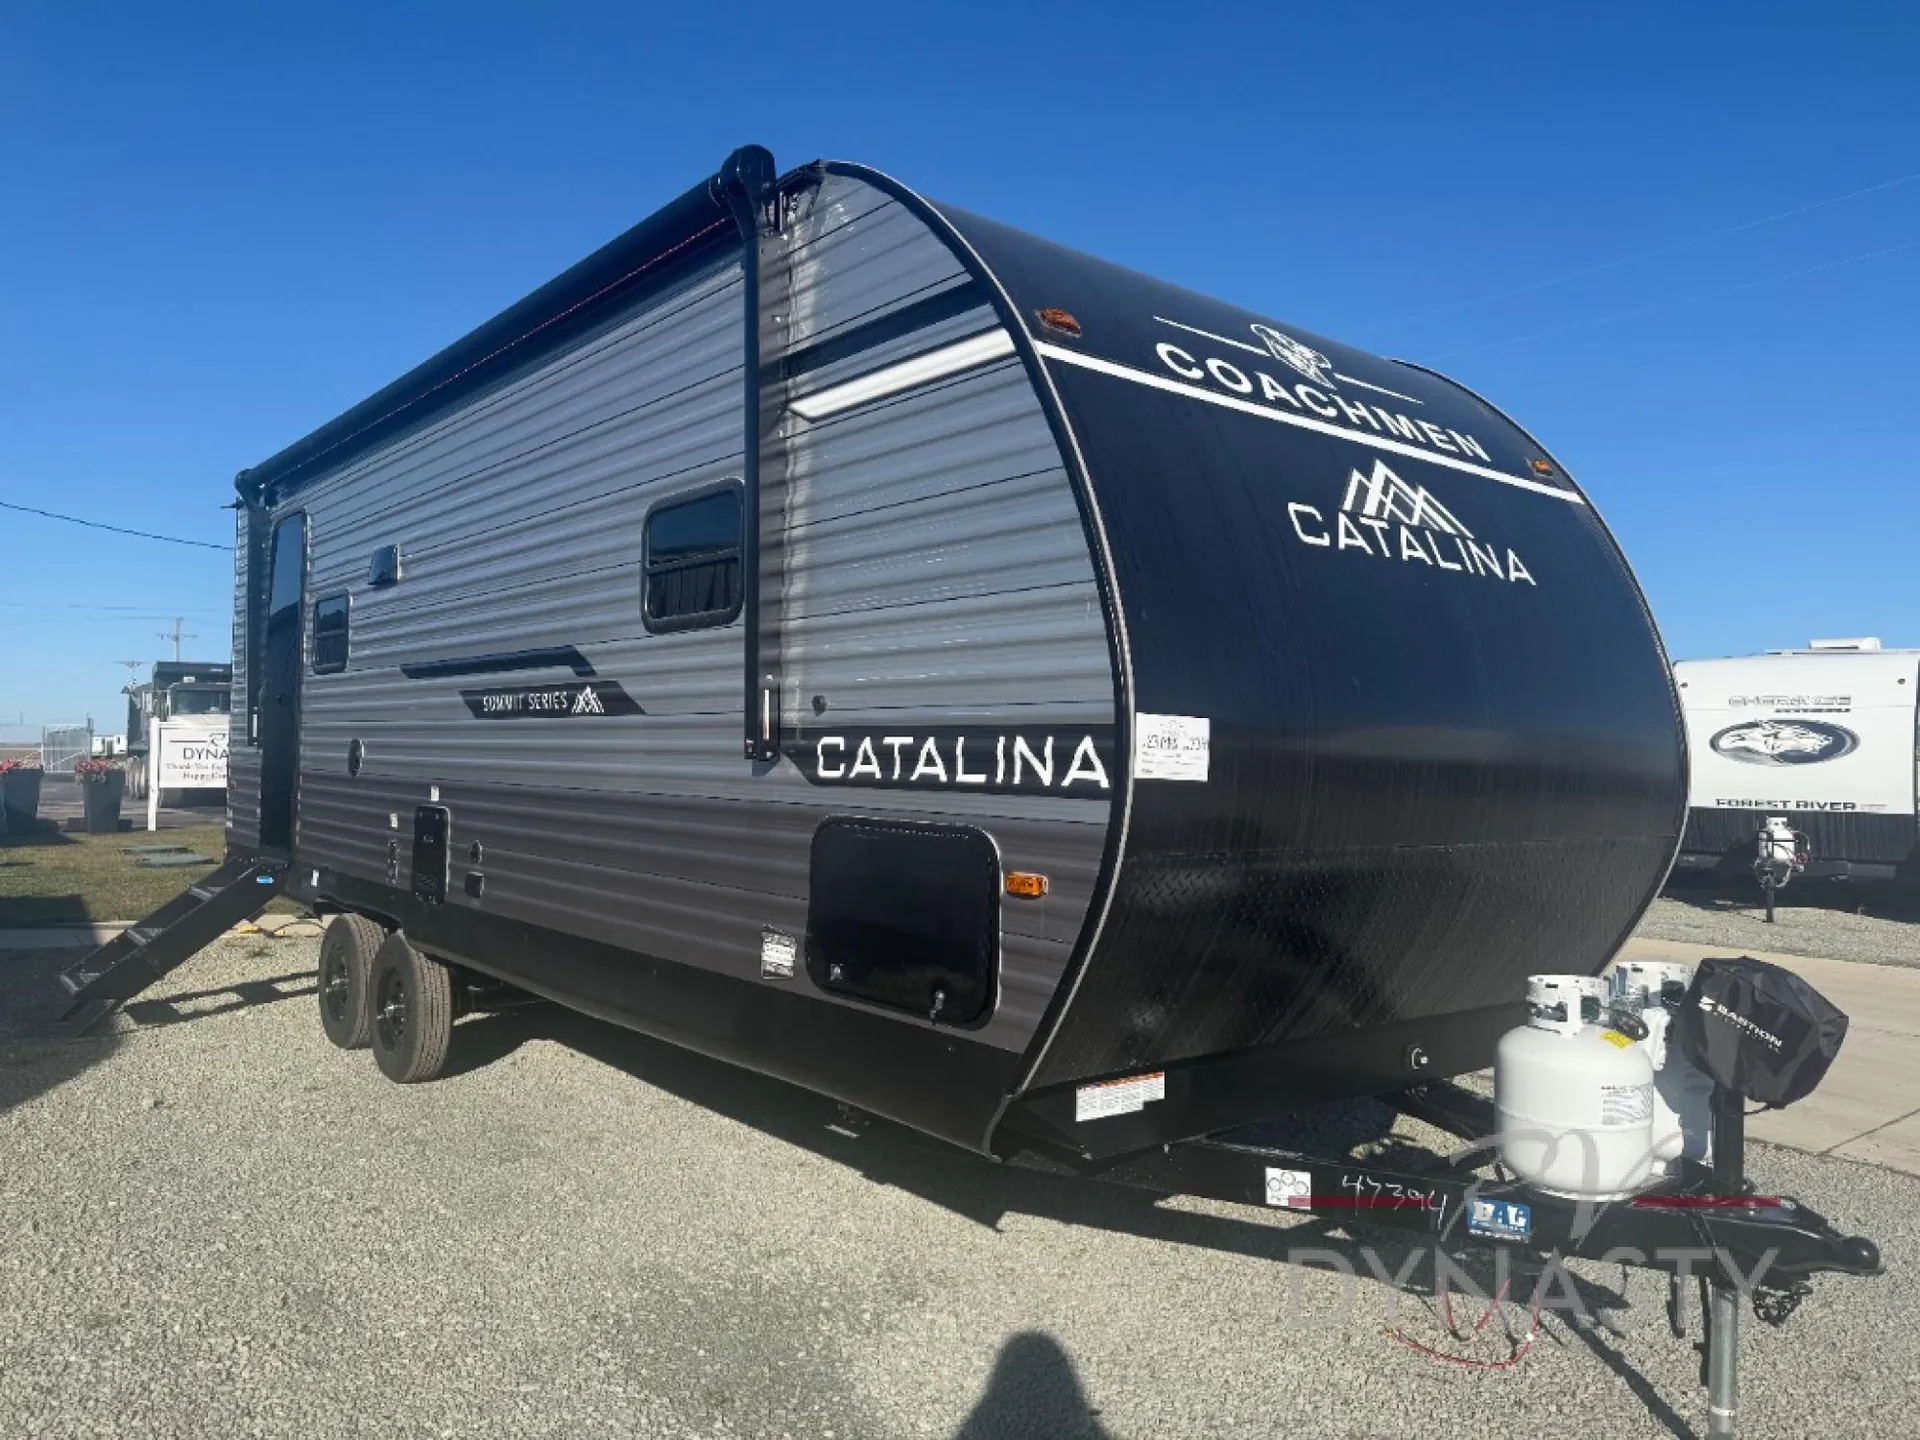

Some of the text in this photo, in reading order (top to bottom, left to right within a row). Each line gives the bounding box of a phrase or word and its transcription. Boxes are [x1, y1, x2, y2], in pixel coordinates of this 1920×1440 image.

[1155, 341, 1492, 462] COACHMEN
[1287, 501, 1537, 586] CATALINA
[483, 691, 568, 711] SUMMIT SERIES
[183, 747, 229, 760] DYNA
[816, 735, 1110, 789] CATALINA
[1715, 798, 1791, 809] FOREST
[1795, 799, 1857, 811] RIVER
